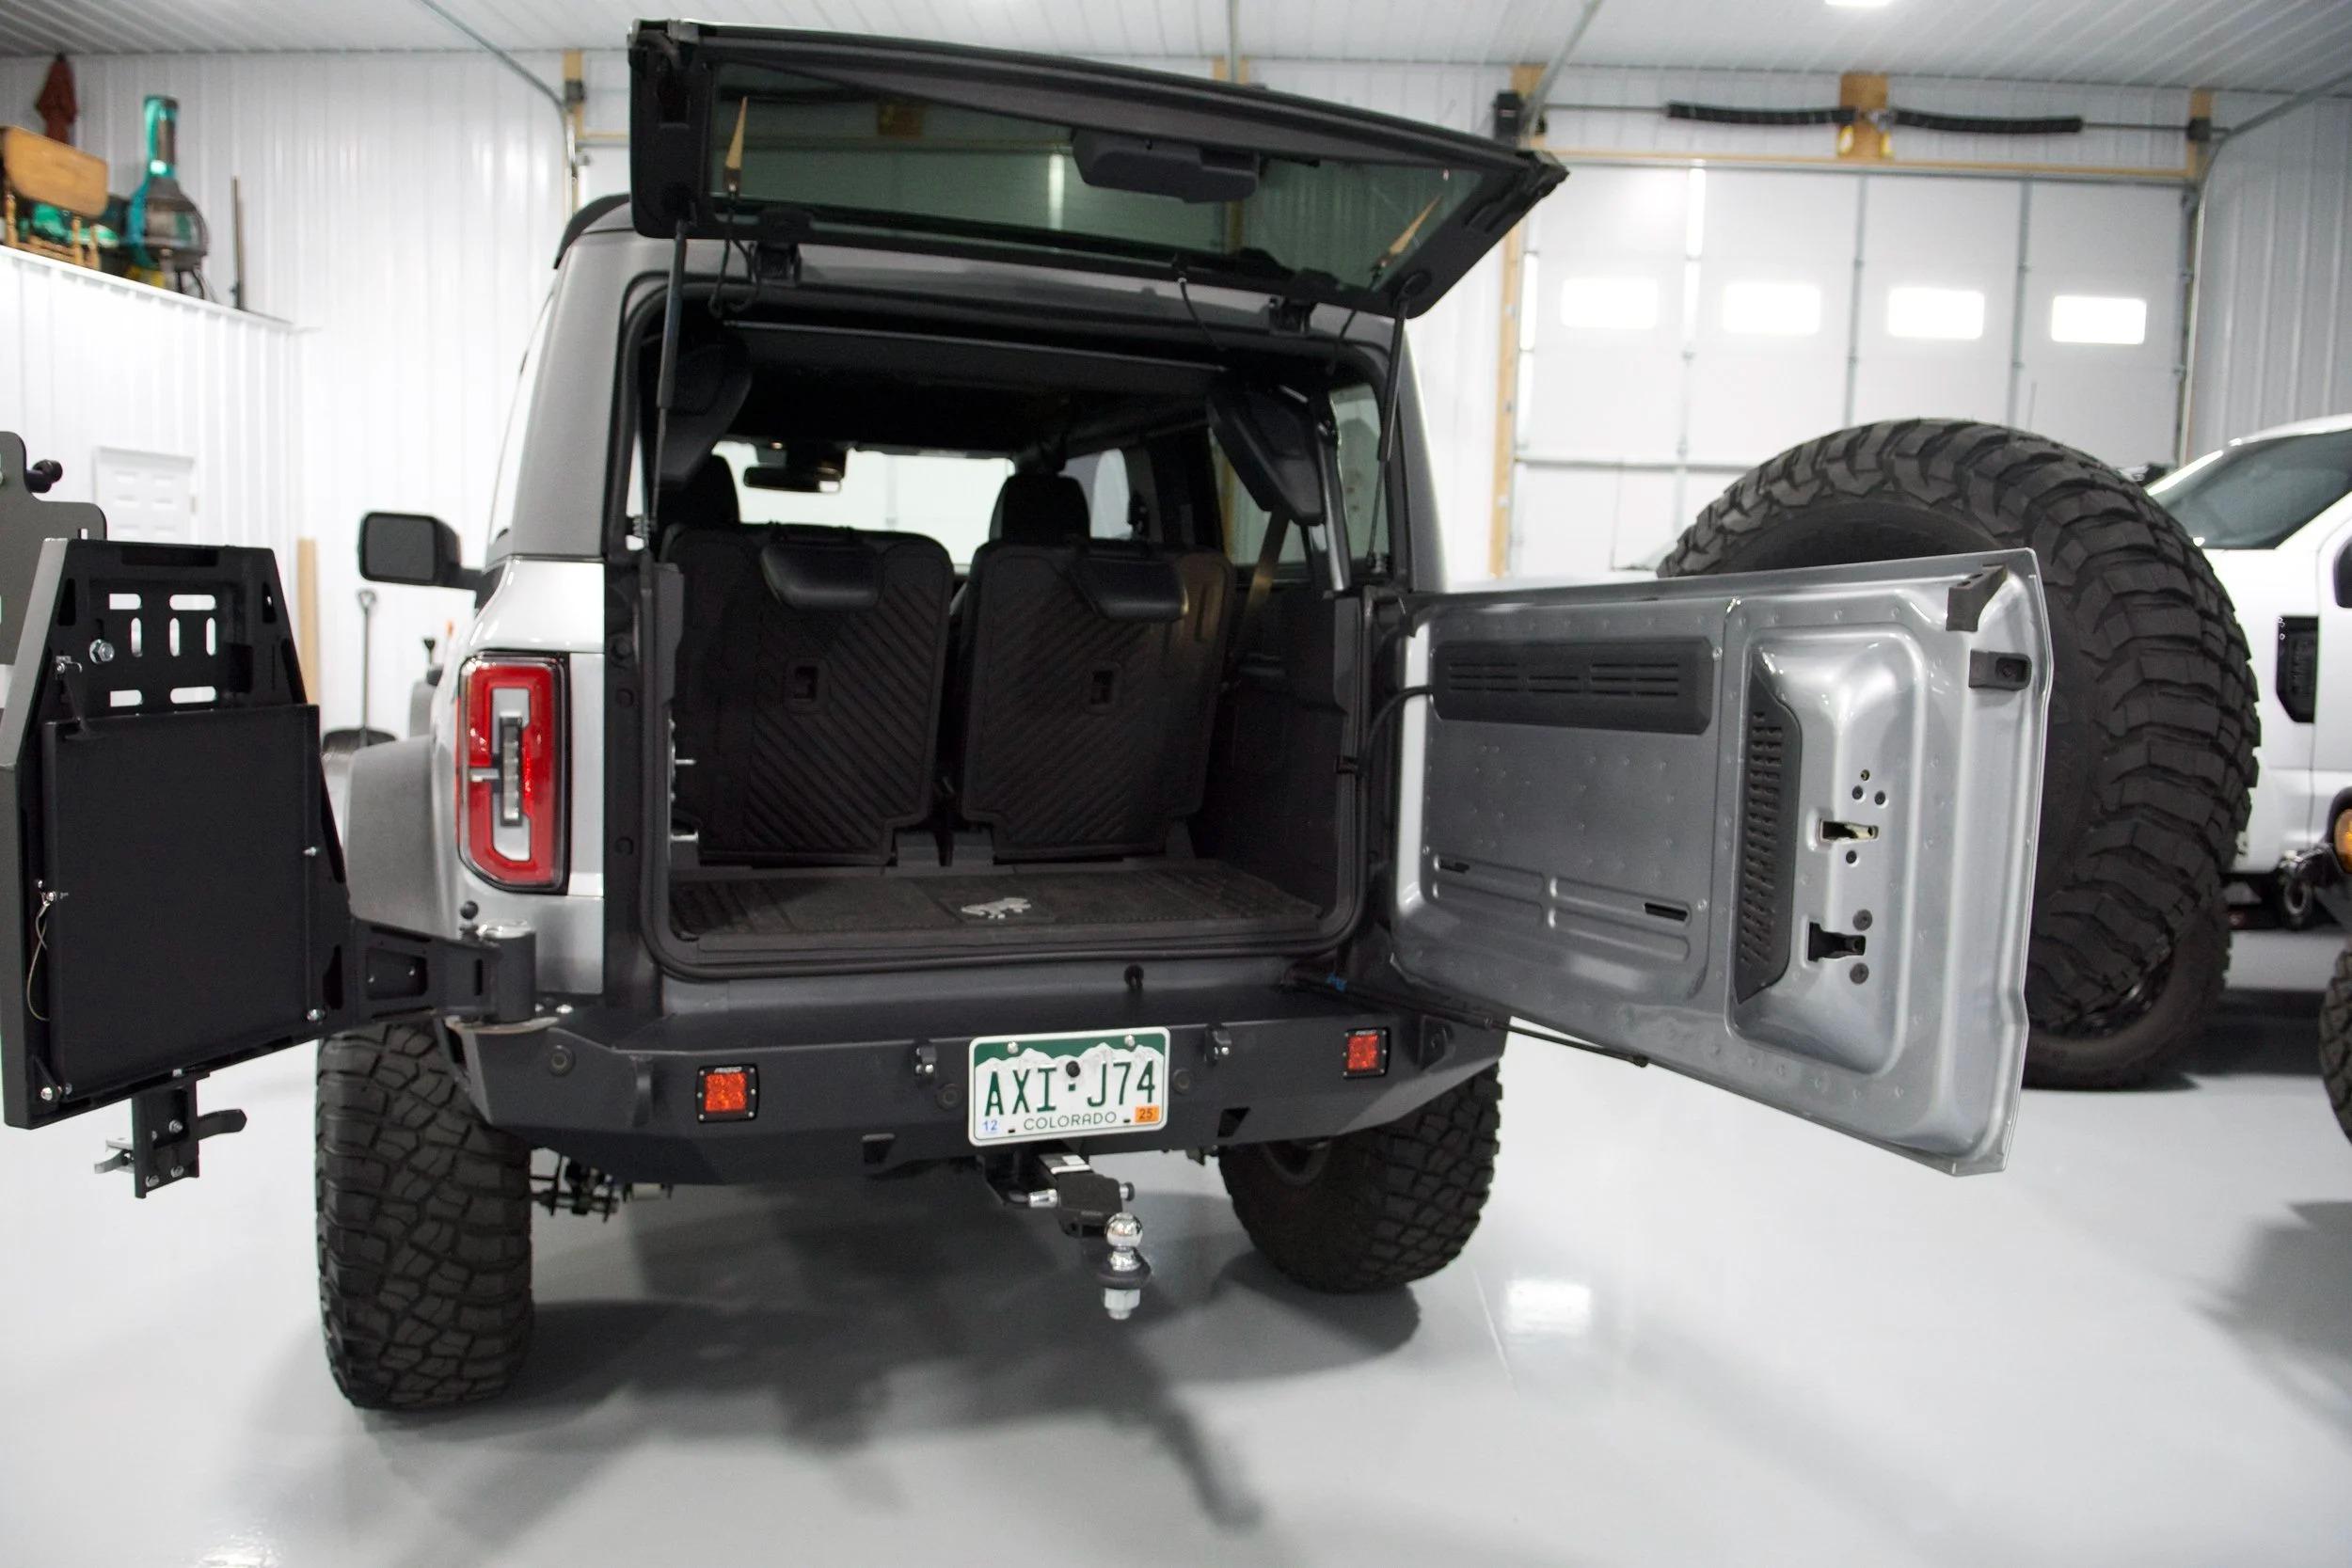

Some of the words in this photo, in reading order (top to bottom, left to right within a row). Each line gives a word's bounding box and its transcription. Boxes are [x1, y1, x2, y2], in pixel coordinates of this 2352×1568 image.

[1139, 1107, 1153, 1119] 25
[983, 1120, 998, 1132] 12
[1024, 1111, 1117, 1131] COLORADO
